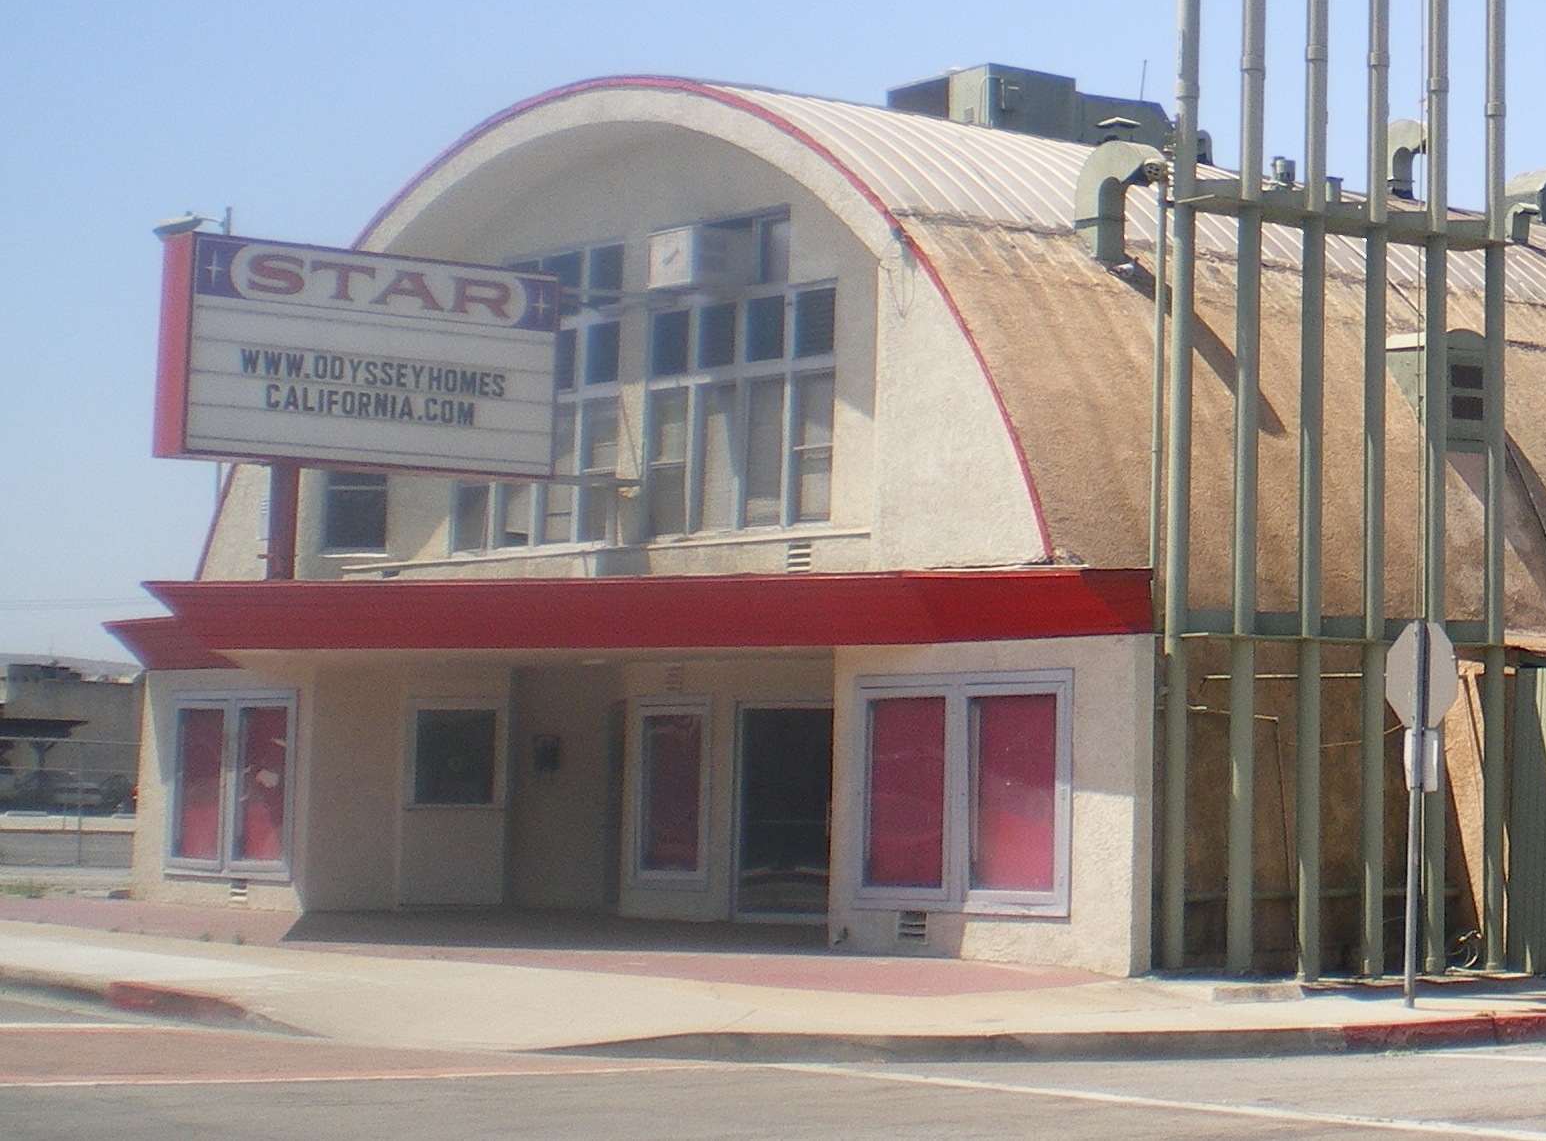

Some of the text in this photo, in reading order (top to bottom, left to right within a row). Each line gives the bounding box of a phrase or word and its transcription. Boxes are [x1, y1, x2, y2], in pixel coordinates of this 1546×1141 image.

[248, 254, 510, 319] STAR
[241, 349, 506, 398] WWW.ODYSSEYHOMES
[265, 384, 475, 426] CALIFORNIA.COM
